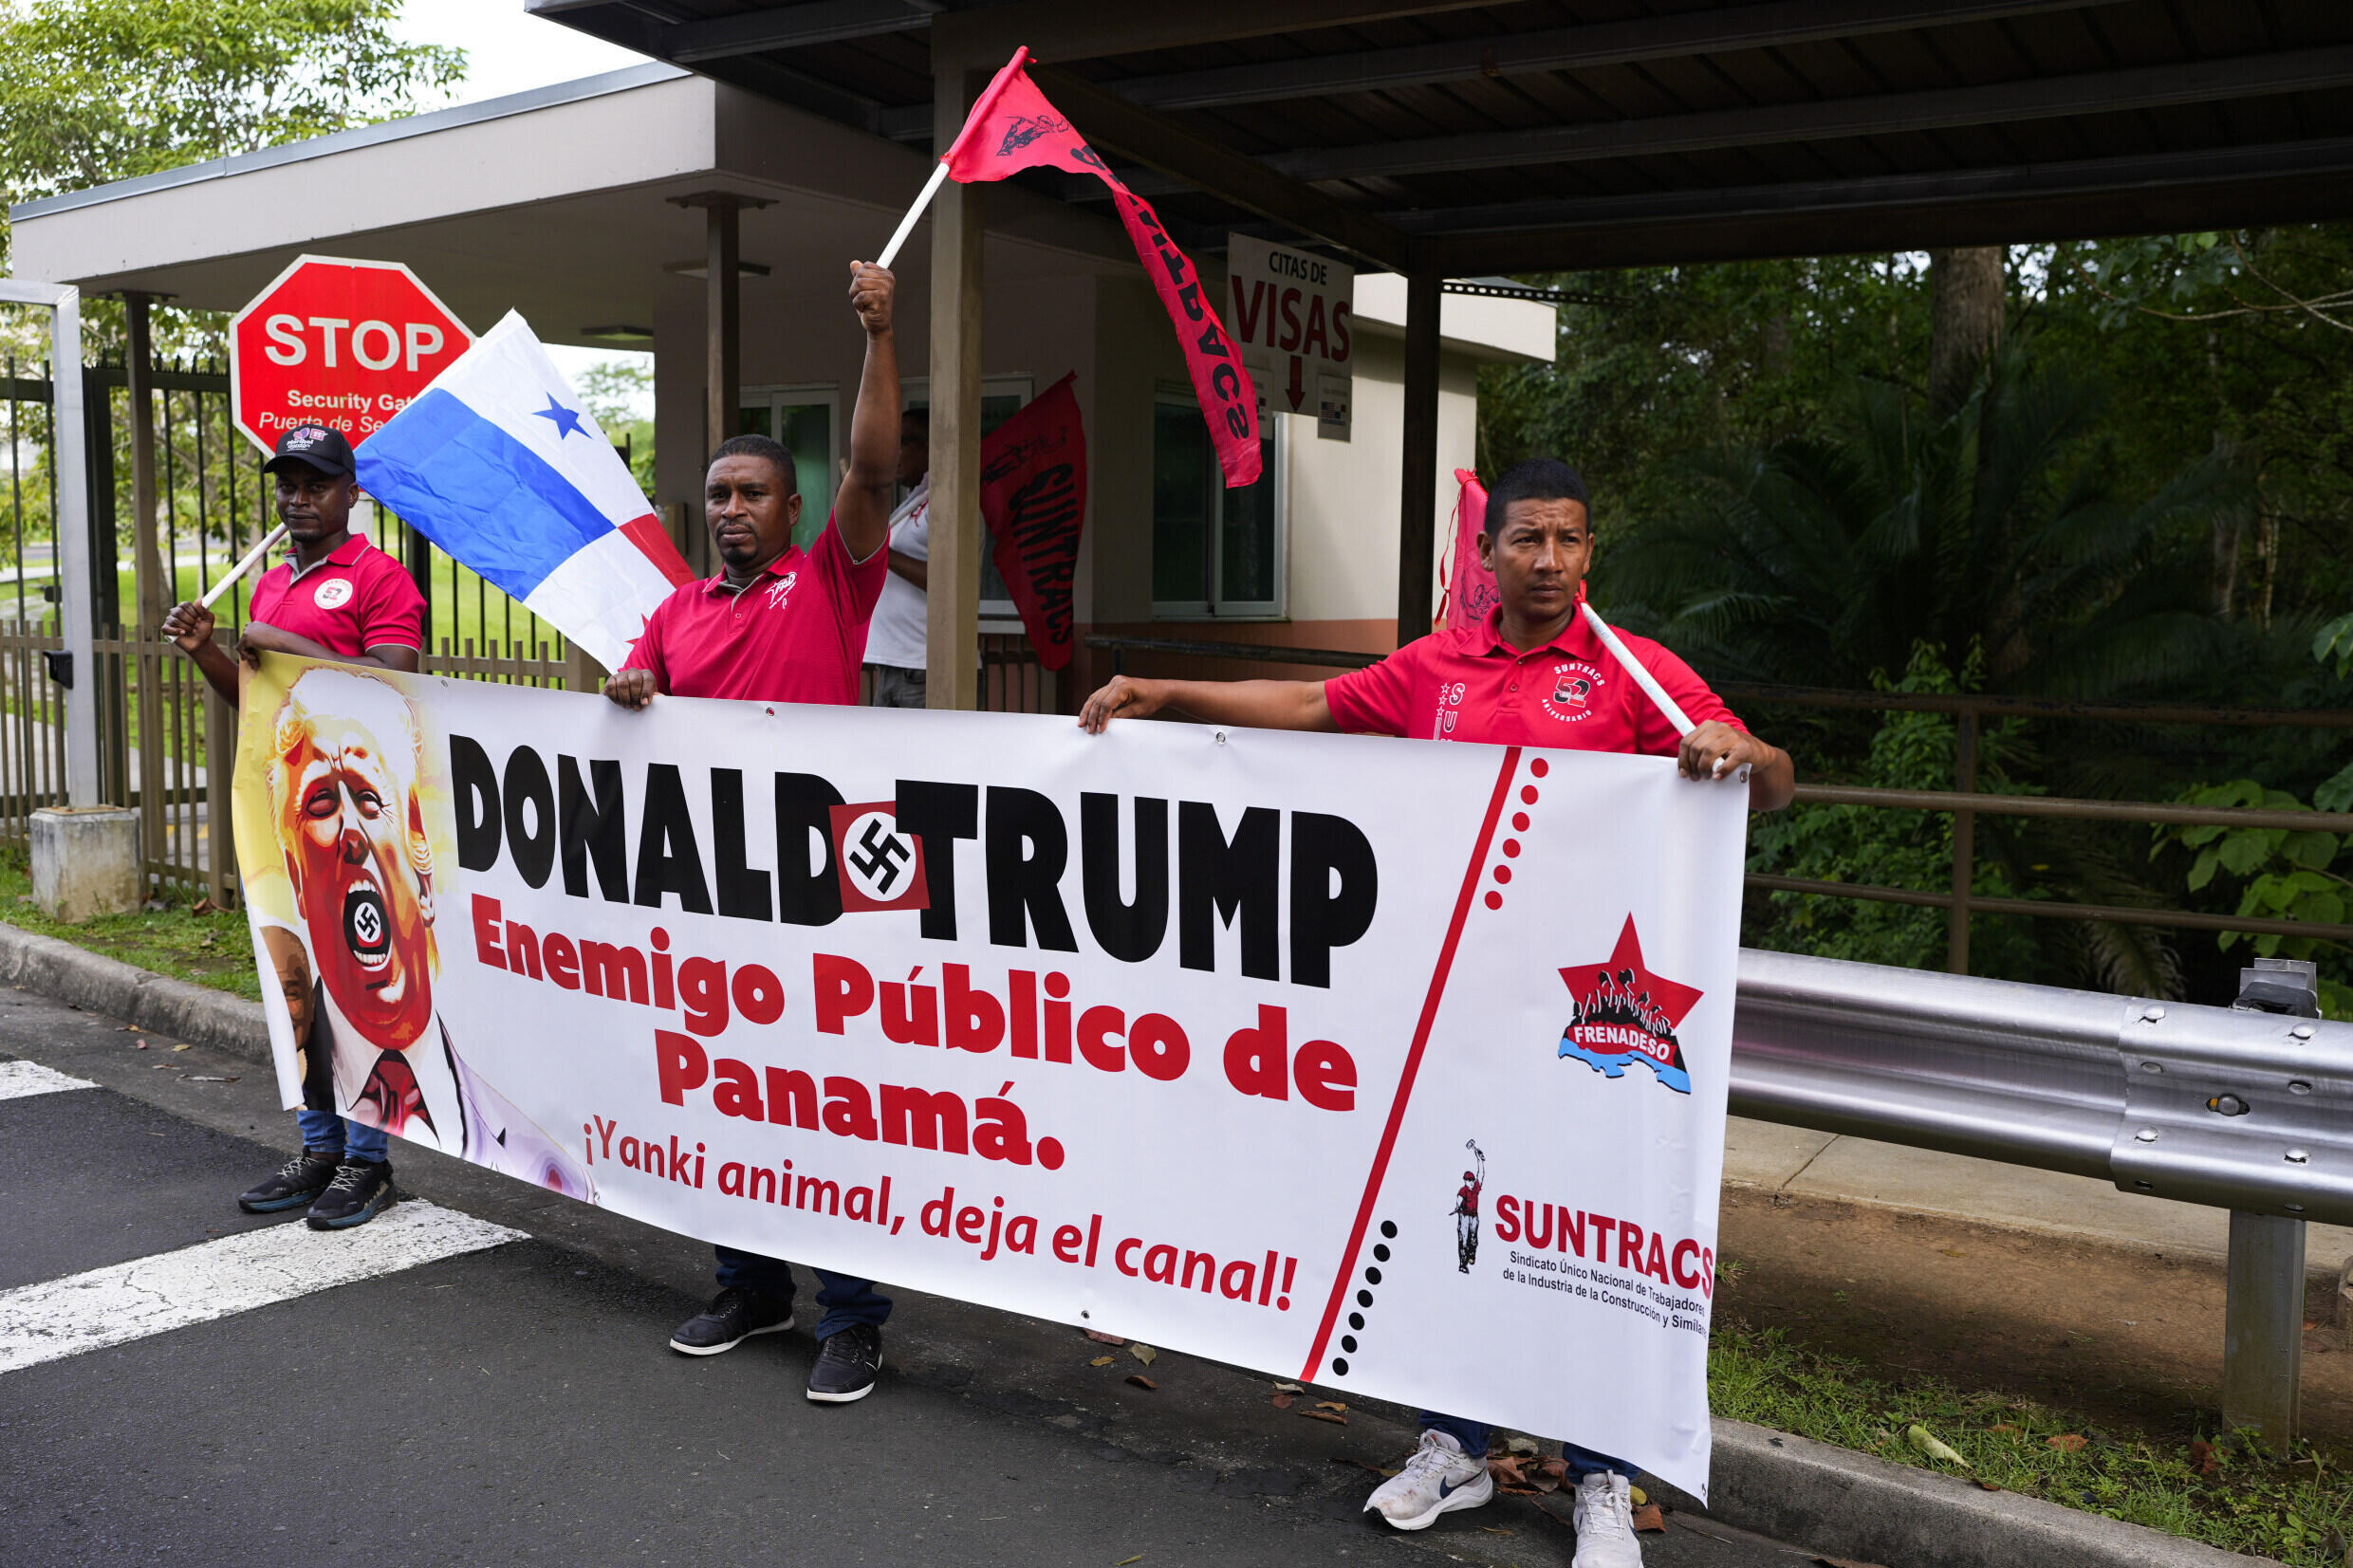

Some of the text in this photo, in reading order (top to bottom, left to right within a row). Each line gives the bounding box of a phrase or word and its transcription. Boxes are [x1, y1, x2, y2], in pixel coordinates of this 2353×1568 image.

[1269, 251, 1327, 285] CITAS DE
[265, 314, 444, 372] STOP
[1232, 275, 1350, 362] VISAS
[259, 412, 324, 430] Puerta
[328, 415, 353, 433] de
[287, 390, 372, 414] Security
[1009, 463, 1080, 646] SUNTRACS
[1553, 663, 1605, 686] SUNTRACS
[1553, 675, 1591, 709] 52
[1542, 699, 1592, 722] ANIVERSARIO
[450, 734, 1378, 989] DONALD TRUMP
[472, 894, 1358, 1112] Enemigo Público de
[1574, 1026, 1670, 1061] FRENADESO
[655, 1029, 1065, 1171] Panamá.
[584, 1115, 1298, 1312] ¡Yanki animal, deja el canal!
[1495, 1195, 1714, 1300] SUNTRACS
[1510, 1250, 1557, 1272] Sindicato
[1560, 1258, 1588, 1280] Único
[1590, 1268, 1634, 1291] Nacional
[1636, 1282, 1647, 1297] de
[1503, 1268, 1515, 1281] de
[1517, 1271, 1526, 1283] la
[1529, 1273, 1573, 1294] Industria
[1575, 1284, 1587, 1298] de
[1589, 1287, 1599, 1301] la
[1602, 1290, 1660, 1323] Construcción
[1662, 1316, 1669, 1329] y
